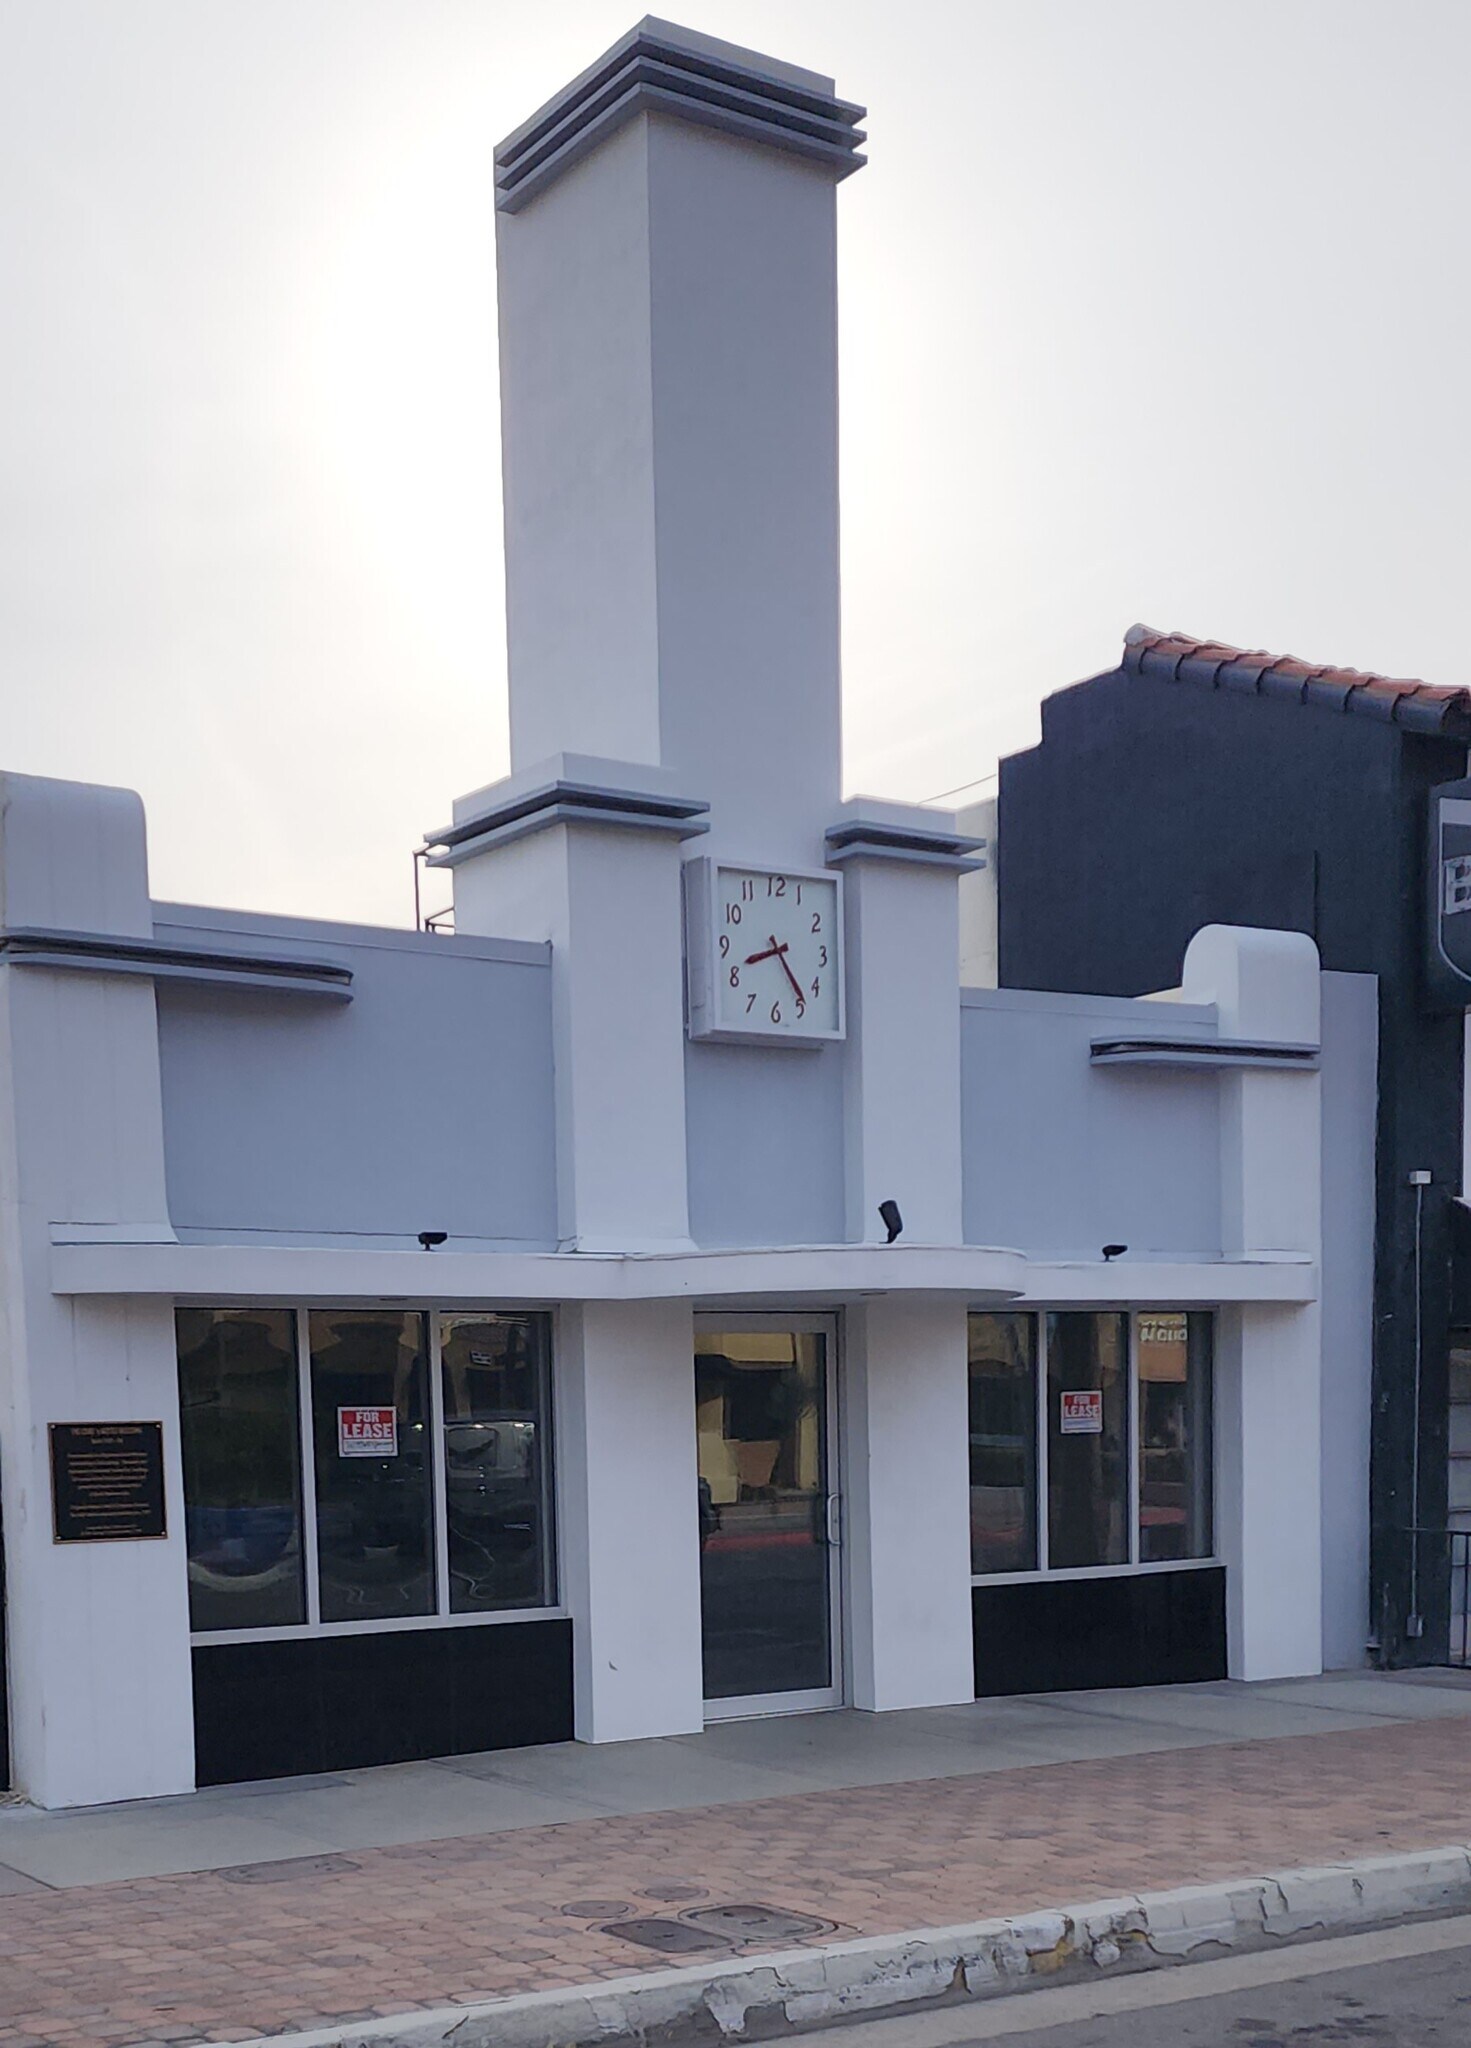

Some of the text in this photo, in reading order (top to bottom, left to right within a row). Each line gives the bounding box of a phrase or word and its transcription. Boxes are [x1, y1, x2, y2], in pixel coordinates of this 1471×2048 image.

[742, 880, 753, 901] 11
[768, 876, 787, 897] 12
[726, 903, 742, 925] 10
[811, 912, 821, 933] 2
[719, 935, 730, 959] 9
[819, 945, 828, 968] 3
[729, 966, 740, 987] 8
[811, 976, 820, 998] 4
[746, 993, 757, 1013] 7
[770, 1001, 781, 1023] 6
[795, 999, 805, 1019] 5
[1073, 1395, 1091, 1405] FOR
[355, 1411, 380, 1423] FOR
[1065, 1405, 1100, 1418] LEASE
[343, 1423, 393, 1439] LEASE
